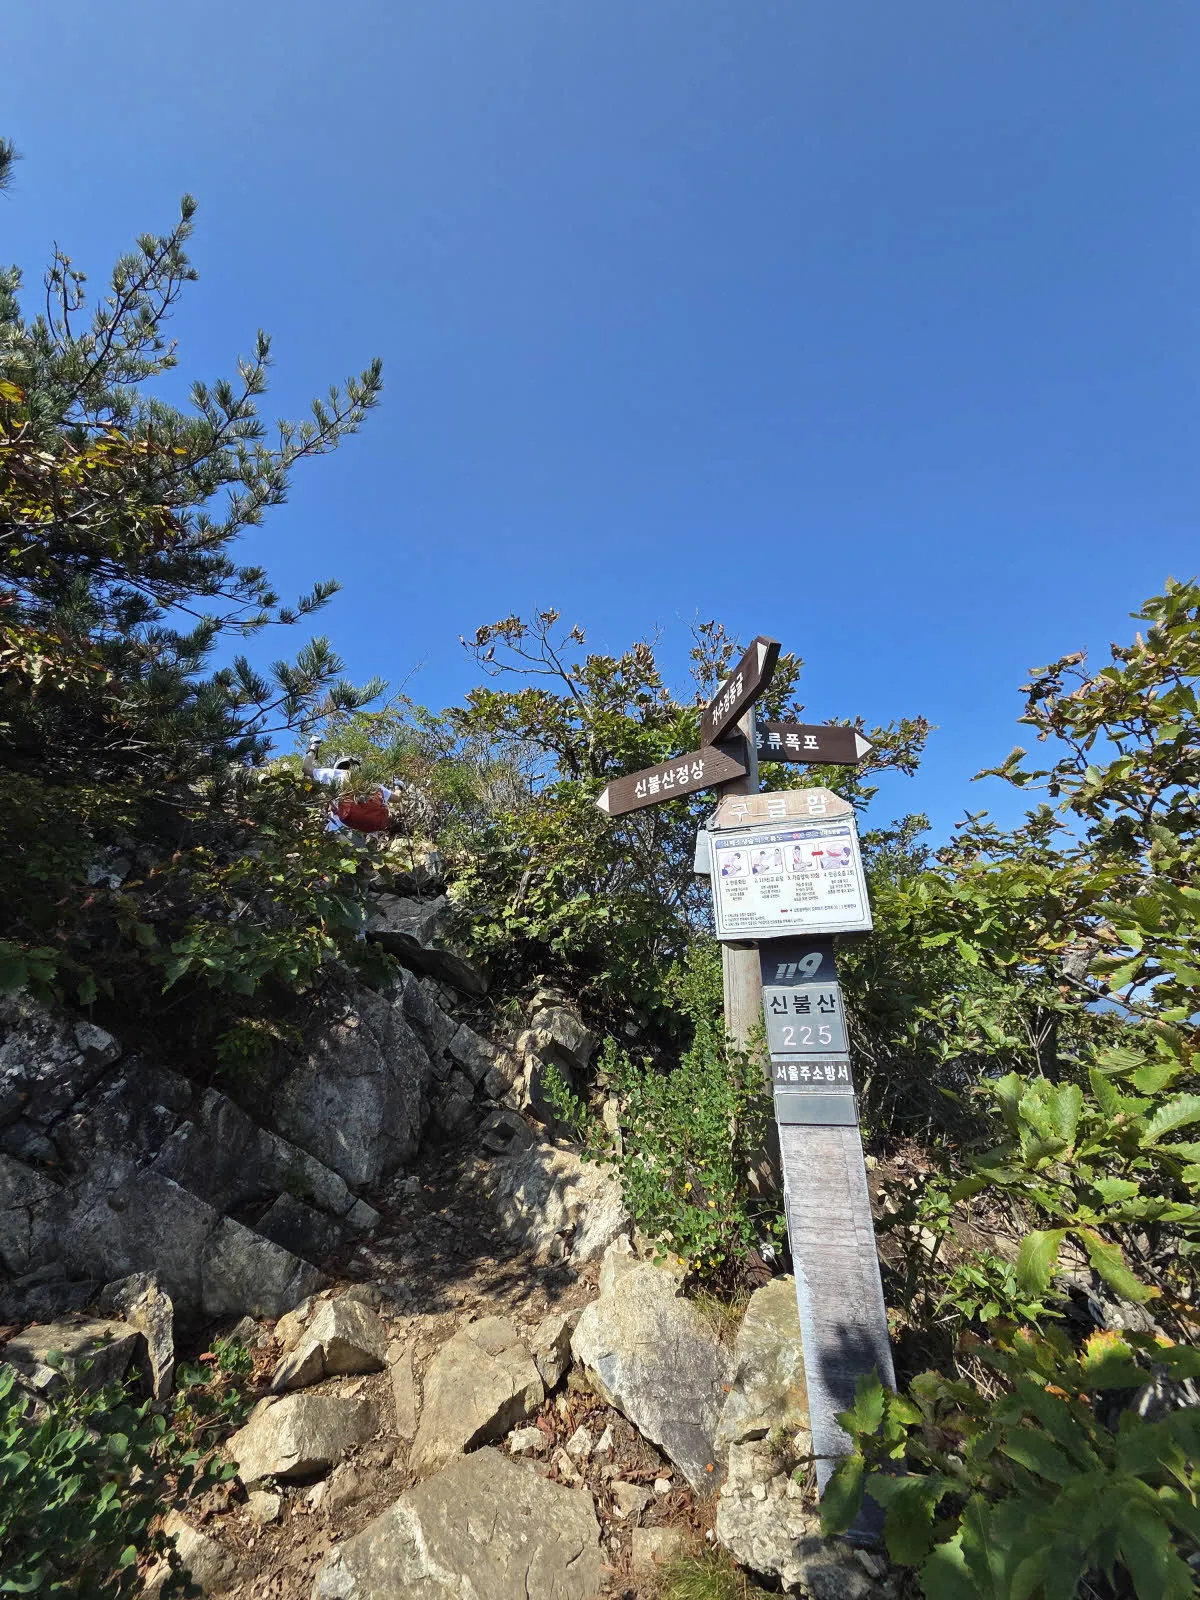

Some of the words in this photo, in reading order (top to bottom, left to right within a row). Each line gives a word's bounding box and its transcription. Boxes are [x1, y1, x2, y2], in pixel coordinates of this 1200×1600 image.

[712, 672, 743, 725] 자수정동굴
[634, 759, 705, 799] 신불산정상
[729, 794, 828, 823] 구급함
[775, 952, 824, 979] 119
[769, 994, 836, 1015] 신불산
[782, 1025, 832, 1046] 225
[776, 1065, 849, 1081] 서울주소방서
